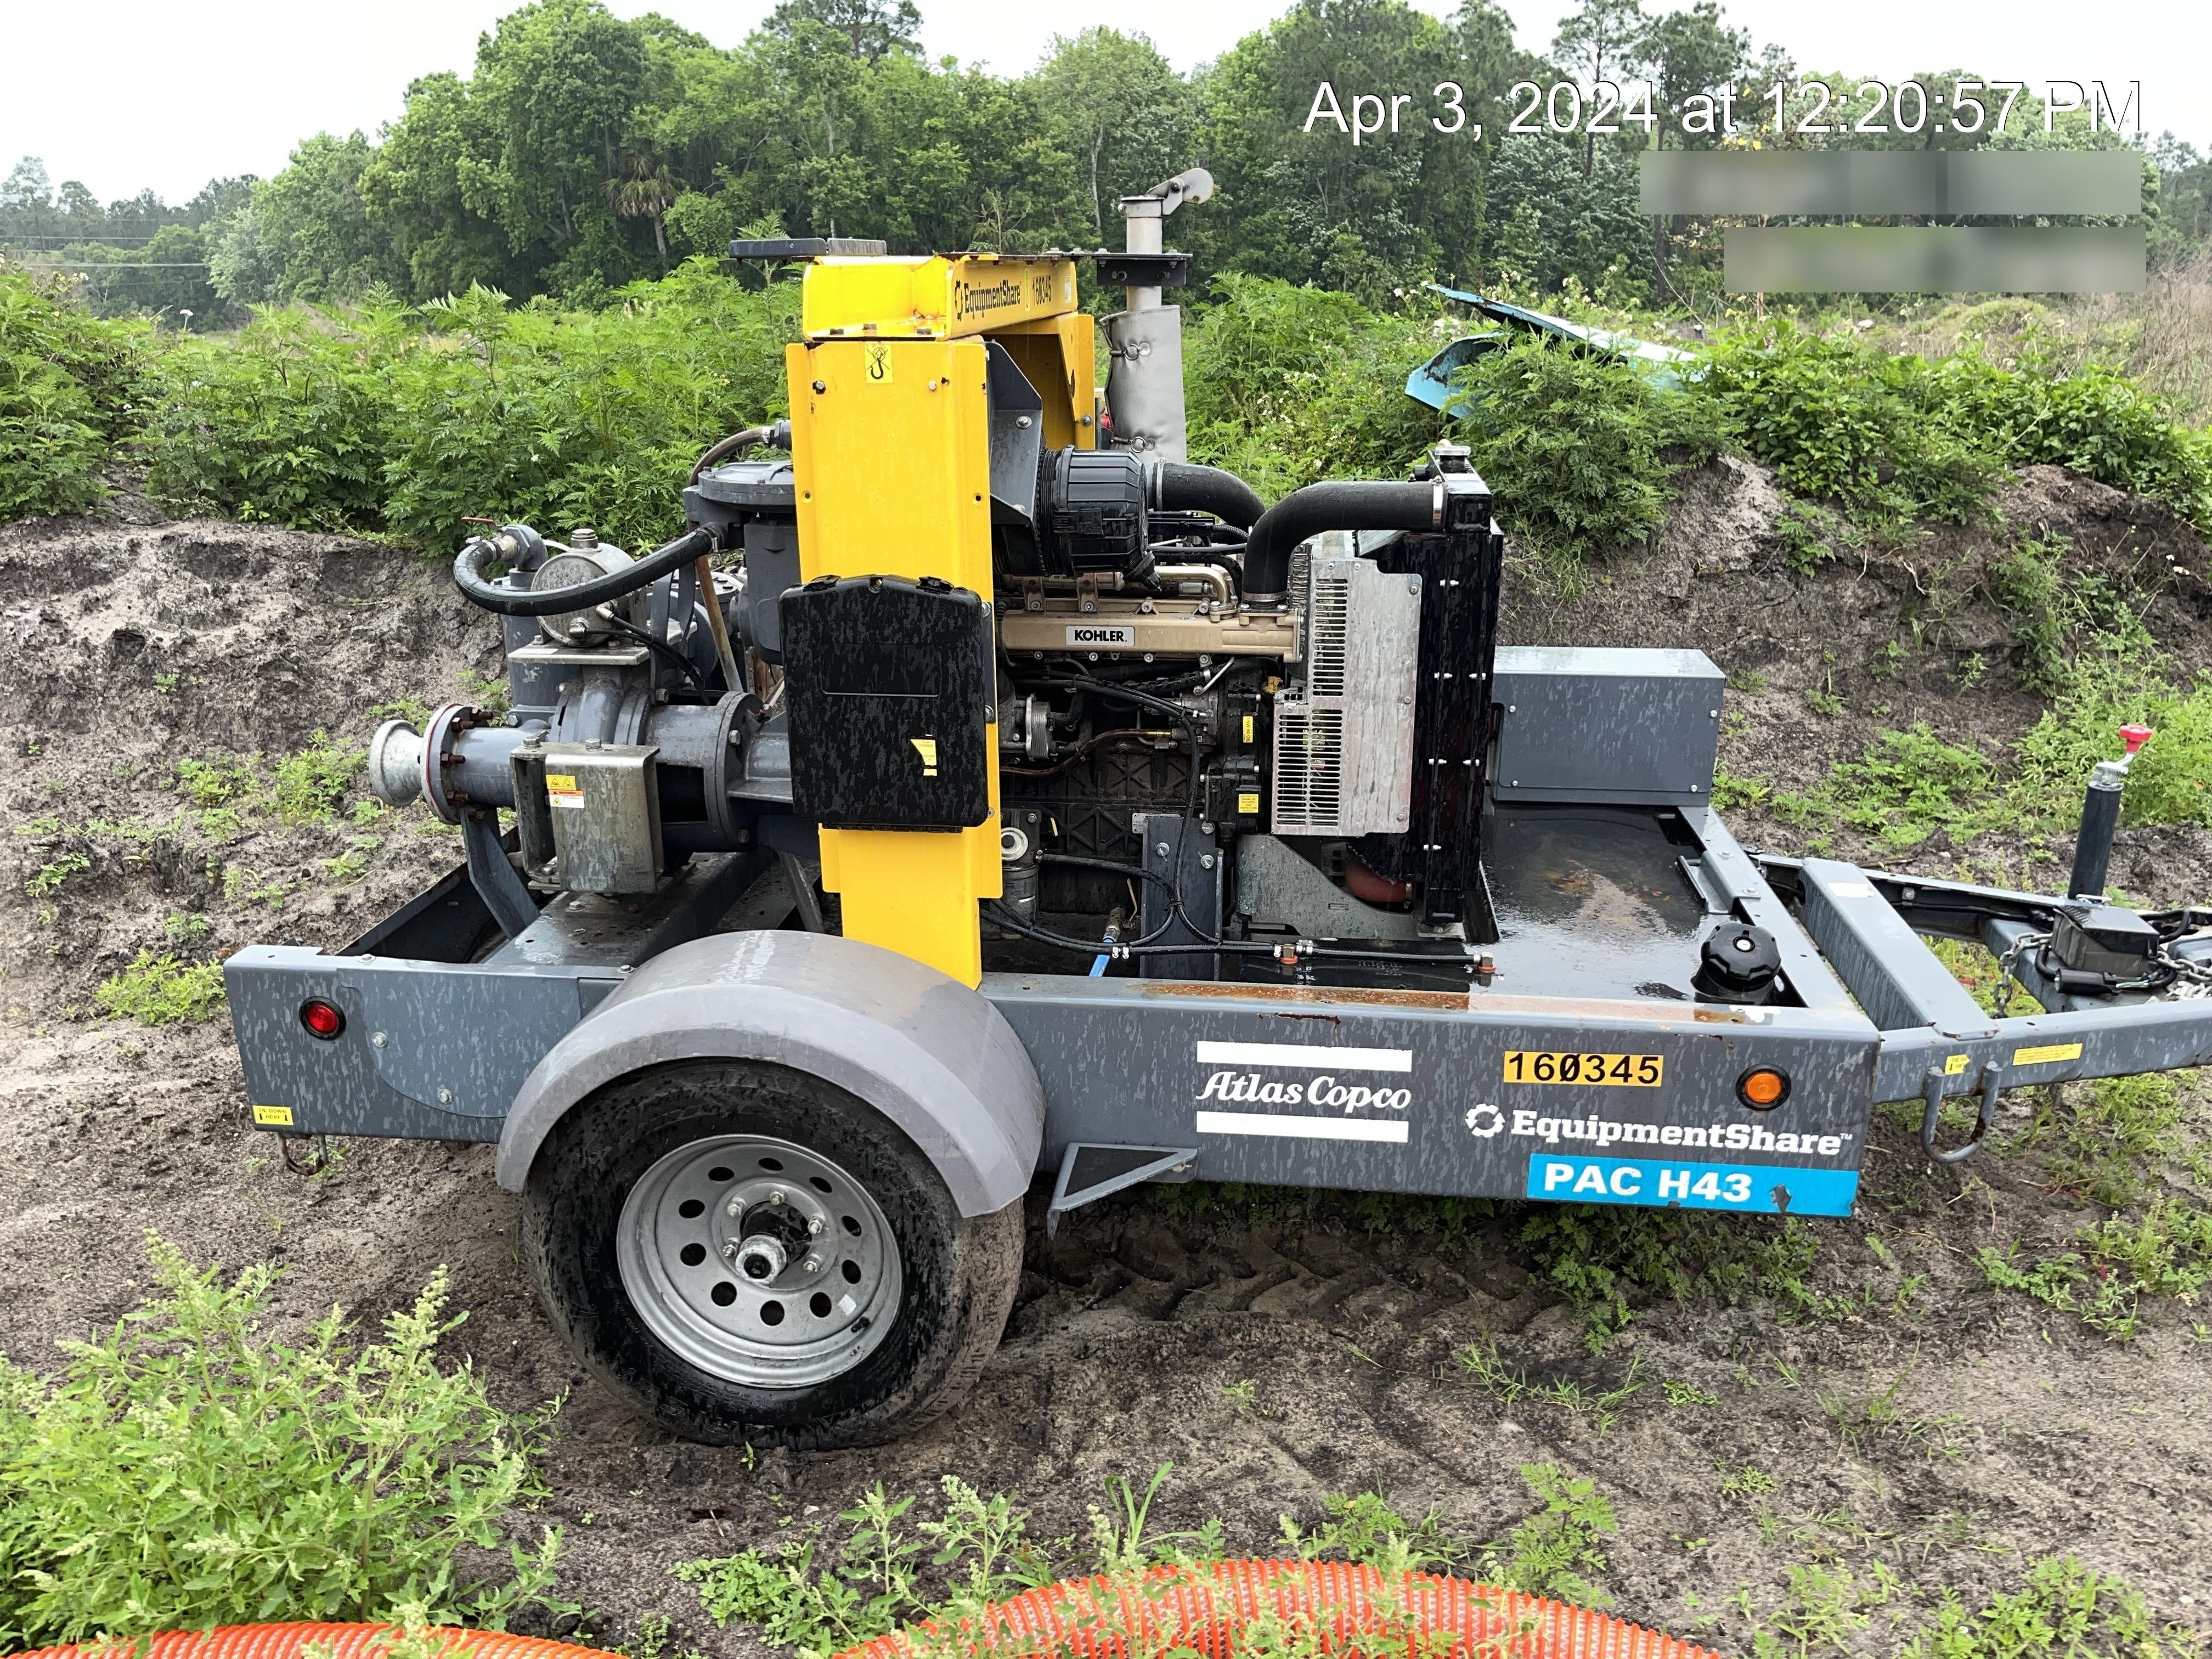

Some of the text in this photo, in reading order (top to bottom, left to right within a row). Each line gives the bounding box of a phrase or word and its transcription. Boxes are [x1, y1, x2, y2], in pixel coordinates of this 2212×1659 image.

[1032, 275, 1052, 306] 160345
[1074, 629, 1125, 642] KOHLER
[1509, 1052, 1659, 1084] 160345
[1195, 1071, 1412, 1114] Atlas Copco
[1544, 1163, 1752, 1203] PAC H43
